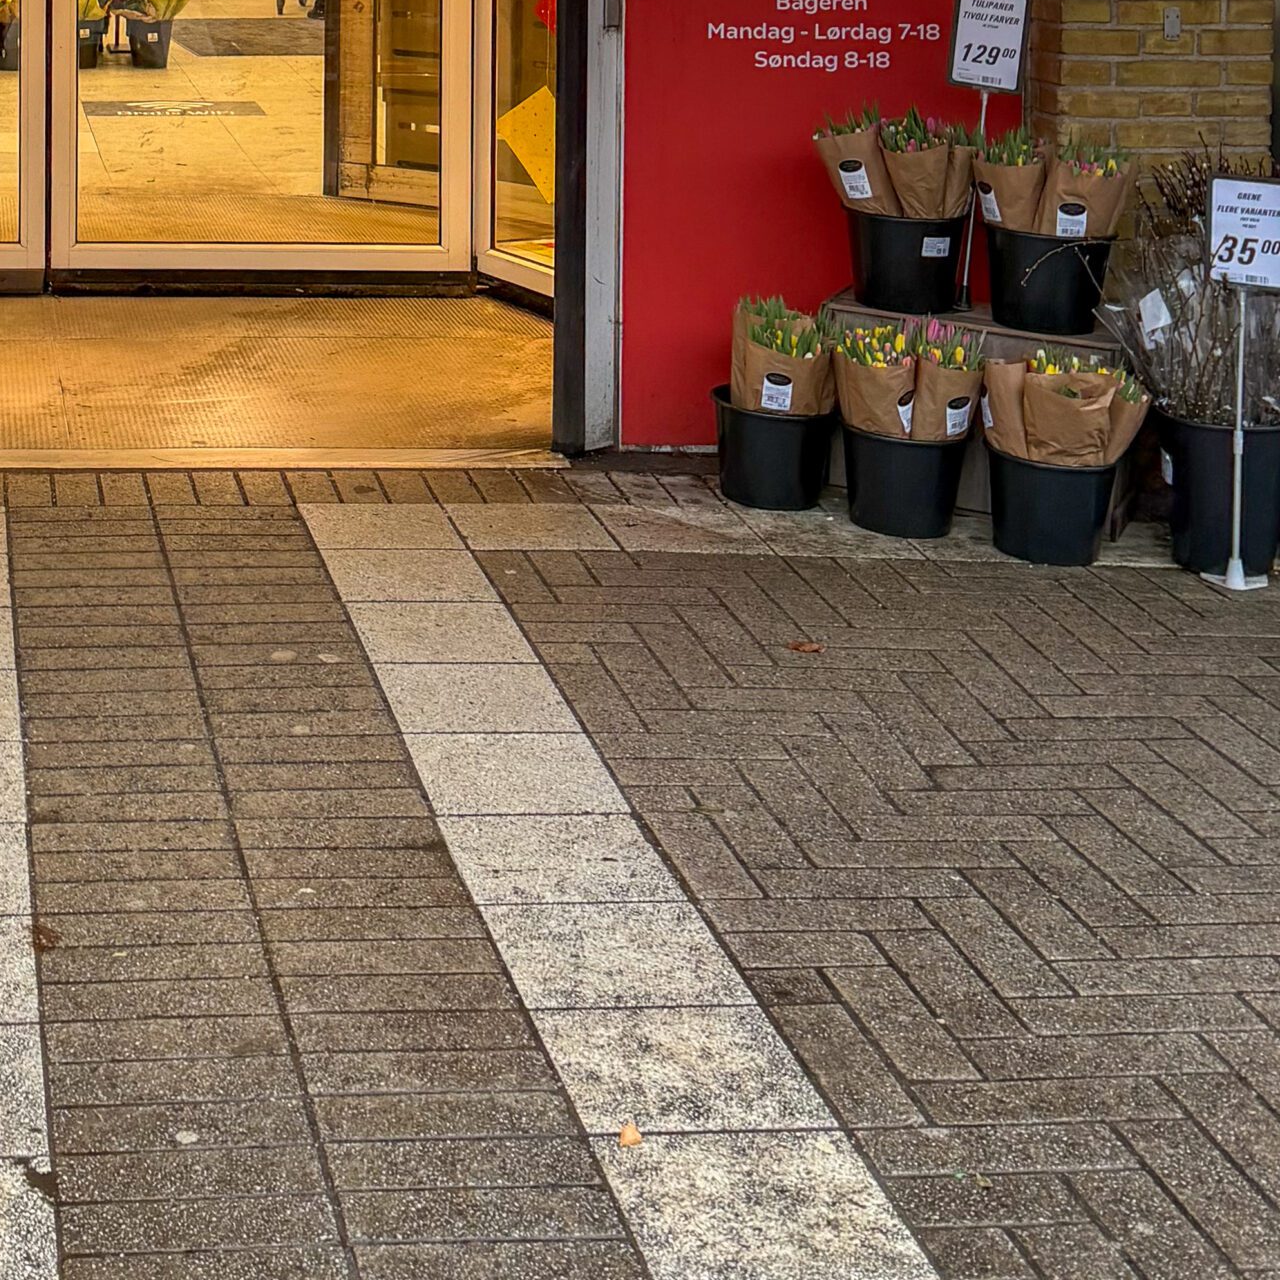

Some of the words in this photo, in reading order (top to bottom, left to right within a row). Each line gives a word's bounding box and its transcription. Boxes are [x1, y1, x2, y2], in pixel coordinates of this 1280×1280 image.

[971, 0, 1015, 12] TULIPANER
[963, 10, 988, 22] TIVOLI
[989, 14, 1020, 26] FARVER
[707, 23, 795, 44] Mandag
[815, 23, 892, 44] Lørdag
[898, 23, 940, 40] 7-18
[754, 51, 839, 72] Søndag
[844, 51, 890, 69] 8-18
[1217, 204, 1239, 215] FLERE
